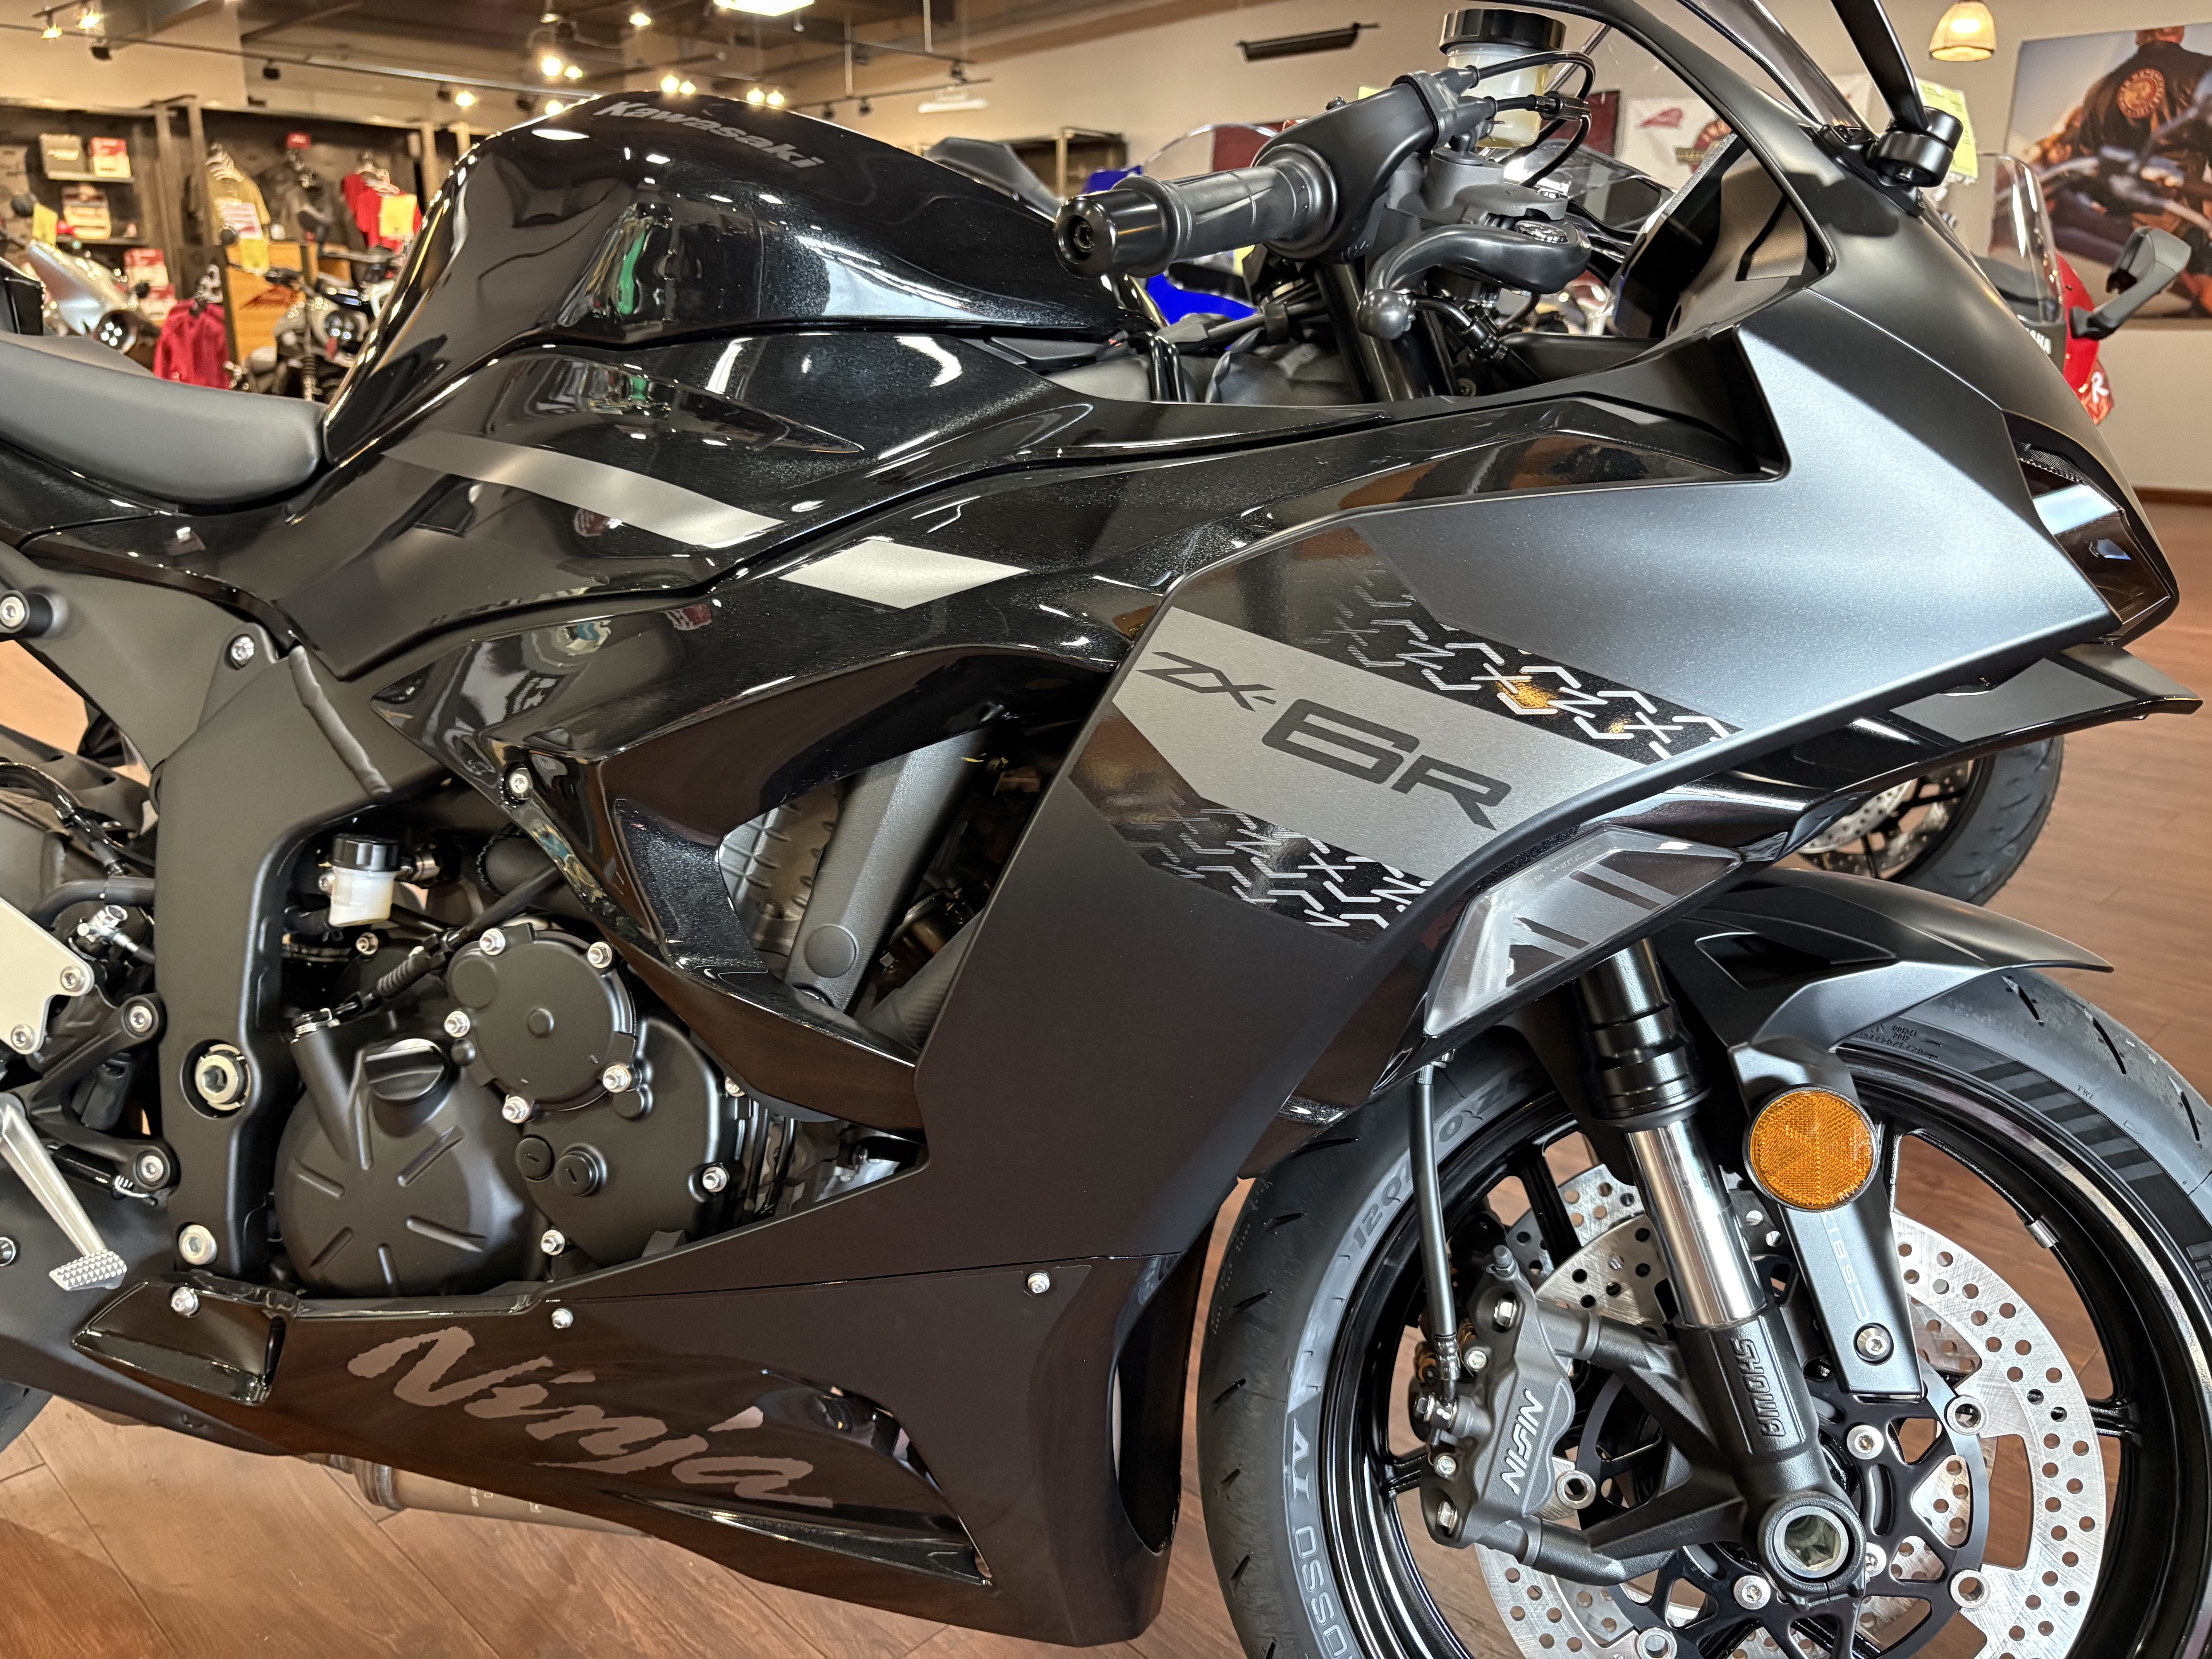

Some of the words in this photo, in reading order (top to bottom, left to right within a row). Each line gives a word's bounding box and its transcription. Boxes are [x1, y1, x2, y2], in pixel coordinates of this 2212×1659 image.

[593, 101, 825, 168] Kawasaki
[1137, 652, 1511, 831] ZX-6R
[348, 1327, 833, 1508] Ninja
[1729, 1338, 1786, 1437] SHOWA
[1295, 1526, 1353, 1659] OSSO
